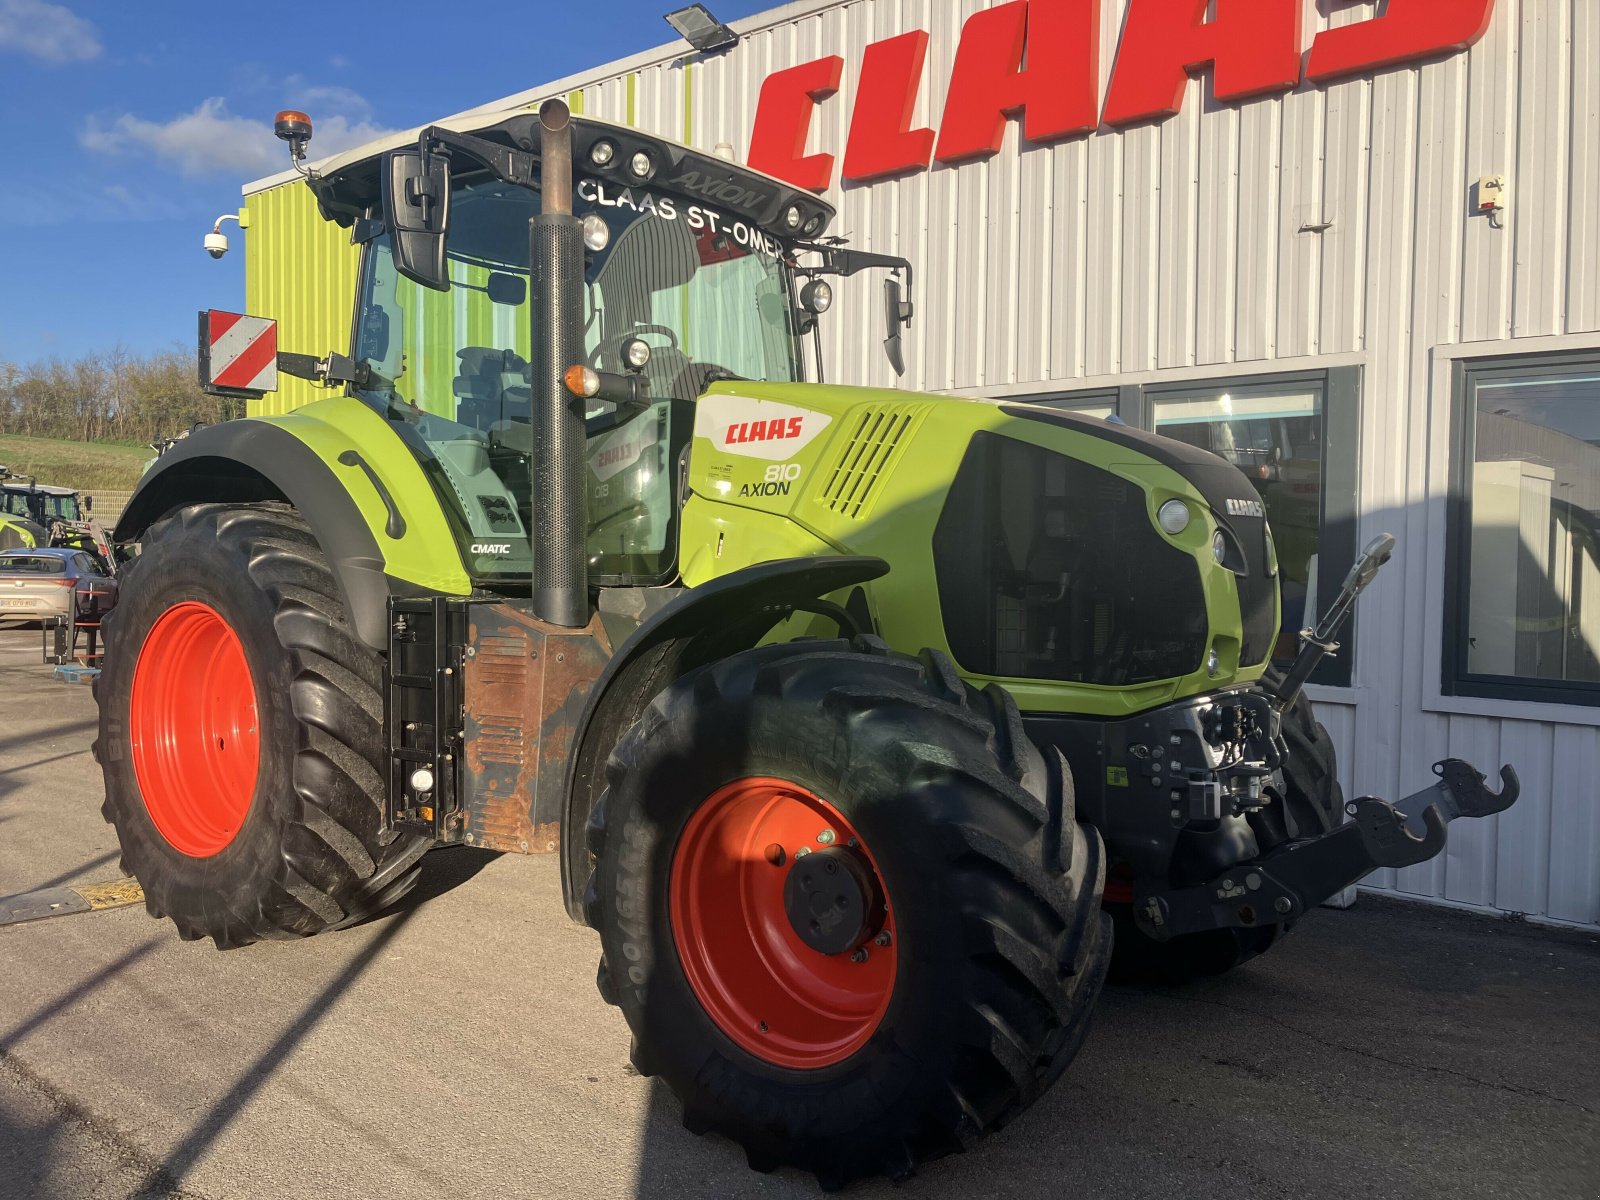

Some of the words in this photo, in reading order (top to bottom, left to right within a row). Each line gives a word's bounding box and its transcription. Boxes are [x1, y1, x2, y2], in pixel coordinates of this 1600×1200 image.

[669, 171, 767, 209] AXION
[577, 178, 677, 220] CLAAS
[687, 205, 786, 261] ST-OMER
[725, 416, 804, 444] CLAAS
[764, 463, 801, 482] 810
[738, 481, 791, 497] AXION
[1226, 499, 1263, 517] CLAAS
[470, 544, 511, 554] CMATIC
